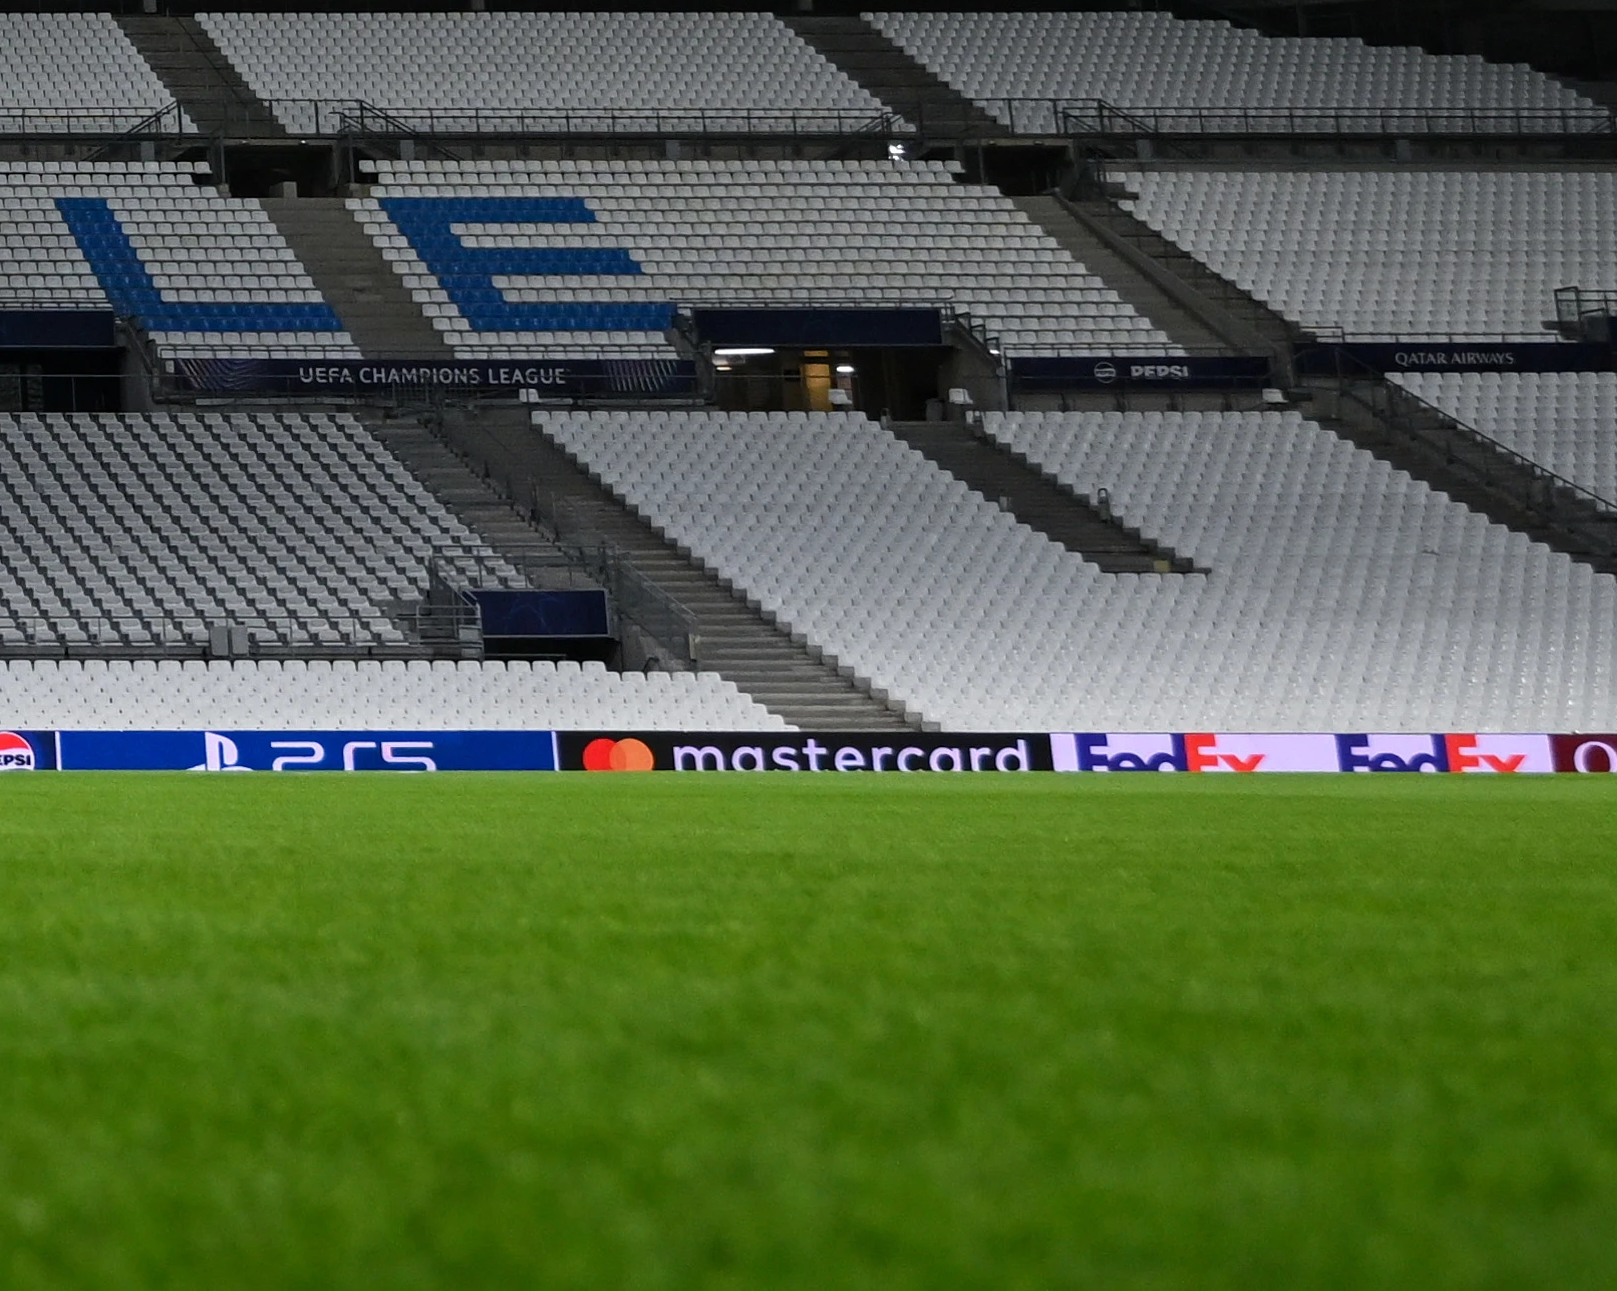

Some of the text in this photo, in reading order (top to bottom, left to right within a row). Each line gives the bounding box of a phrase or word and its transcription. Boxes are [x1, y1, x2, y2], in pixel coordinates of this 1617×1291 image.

[1130, 365, 1190, 379] PEPSI
[1394, 352, 1515, 366] QATAR AIRWAYS
[298, 367, 567, 385] UEFA CHAMPIONS LEAGUE
[270, 741, 437, 771] PS5
[672, 738, 1030, 772] mastercard
[1073, 733, 1266, 771] FedEx
[1334, 734, 1527, 772] FedEx
